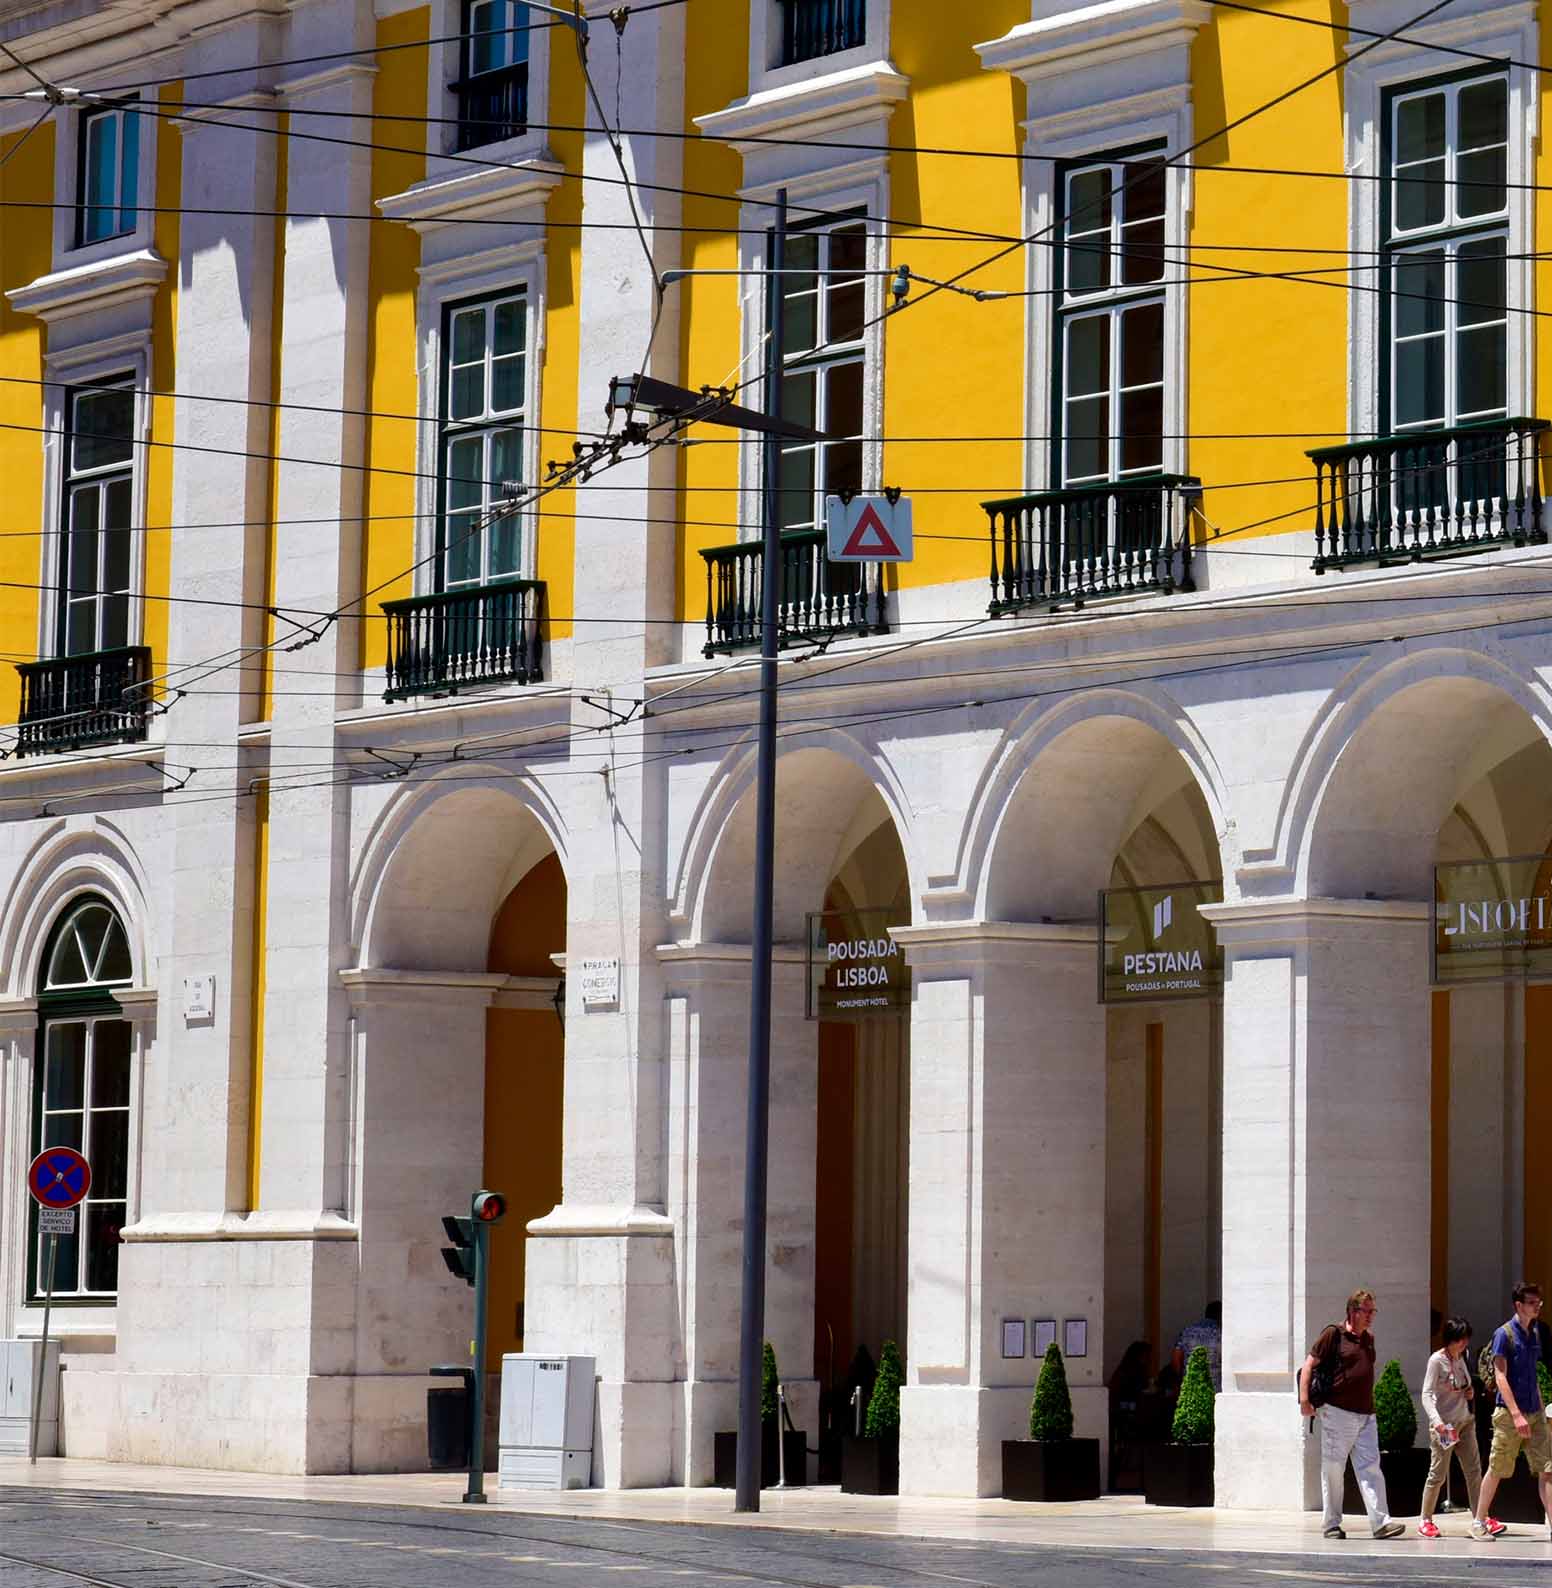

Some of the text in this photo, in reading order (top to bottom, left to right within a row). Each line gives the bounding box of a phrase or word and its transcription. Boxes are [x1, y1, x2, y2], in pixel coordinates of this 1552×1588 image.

[827, 938, 898, 961] POUSADA
[1123, 950, 1202, 976] PESTANA
[836, 966, 889, 988] LISBOA
[1126, 982, 1160, 992] POUSADAS
[1166, 979, 1201, 990] PORTUGAL
[836, 997, 889, 1009] MONUMENT HOTEL
